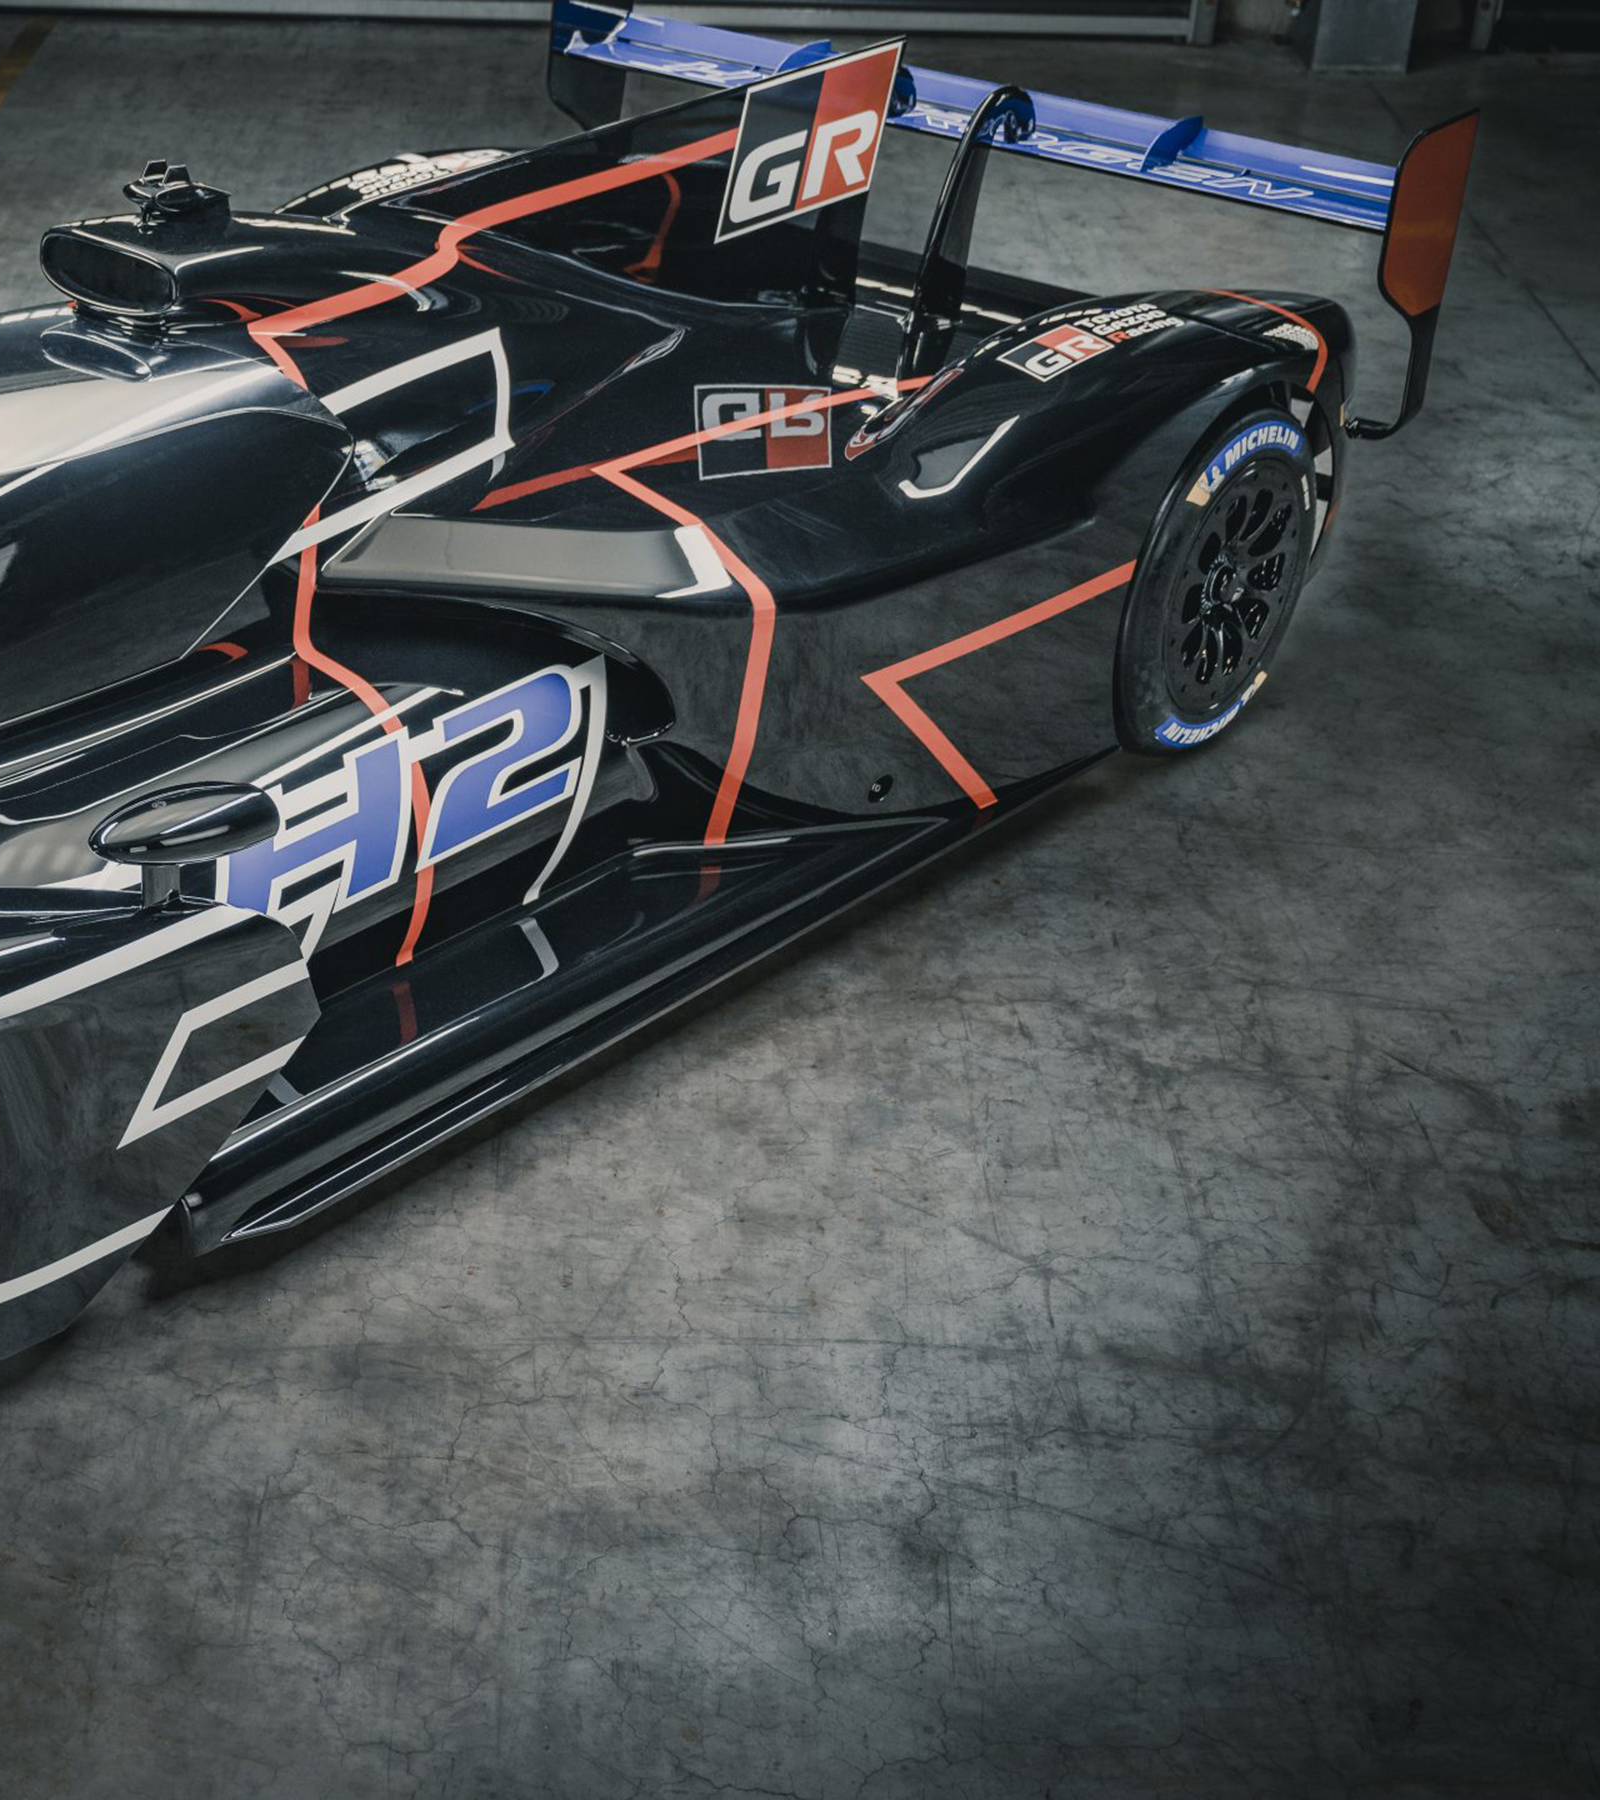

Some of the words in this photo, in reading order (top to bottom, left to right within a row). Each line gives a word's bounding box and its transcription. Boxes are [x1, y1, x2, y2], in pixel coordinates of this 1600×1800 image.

[729, 110, 879, 223] GR
[1073, 303, 1157, 328] TOYOTA
[1092, 310, 1167, 336] GAZOO
[1106, 316, 1185, 343] Racing
[1025, 335, 1108, 376] GR
[1225, 426, 1299, 470] MICHELIN
[216, 664, 583, 914] H2
